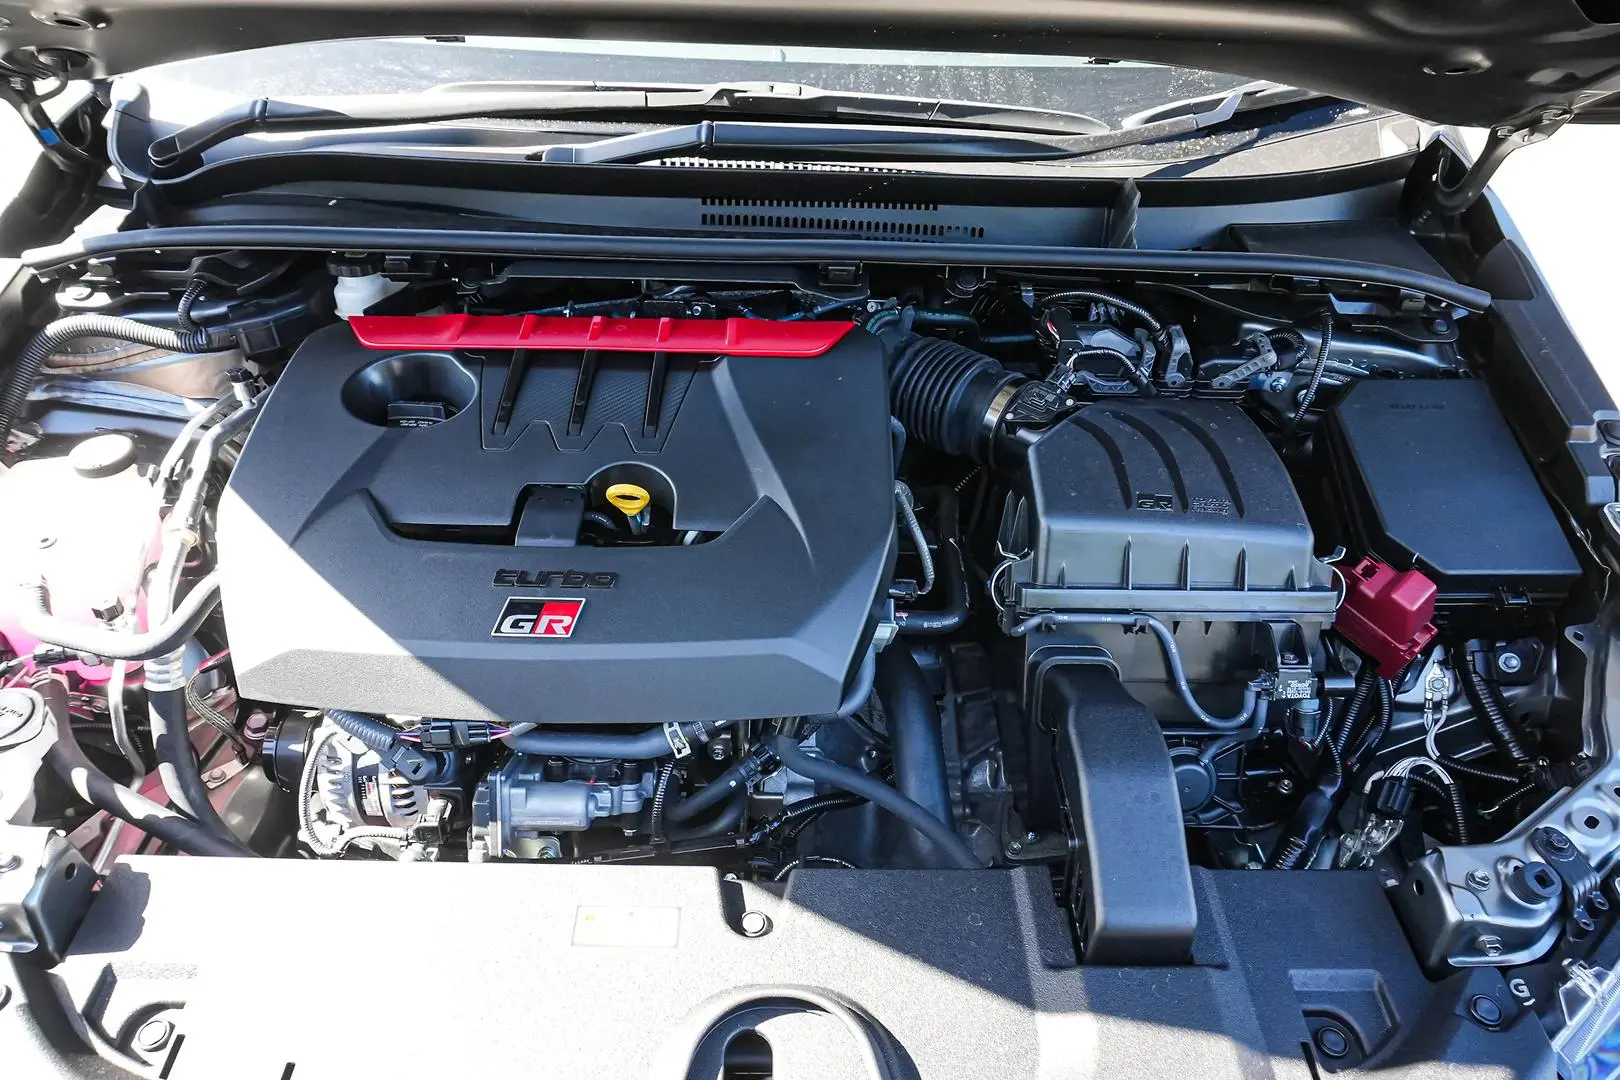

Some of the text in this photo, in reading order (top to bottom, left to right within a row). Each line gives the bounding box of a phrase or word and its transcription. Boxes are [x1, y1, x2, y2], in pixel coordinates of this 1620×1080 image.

[1137, 497, 1173, 511] GR
[492, 569, 619, 588] turbo
[500, 615, 573, 635] GR
